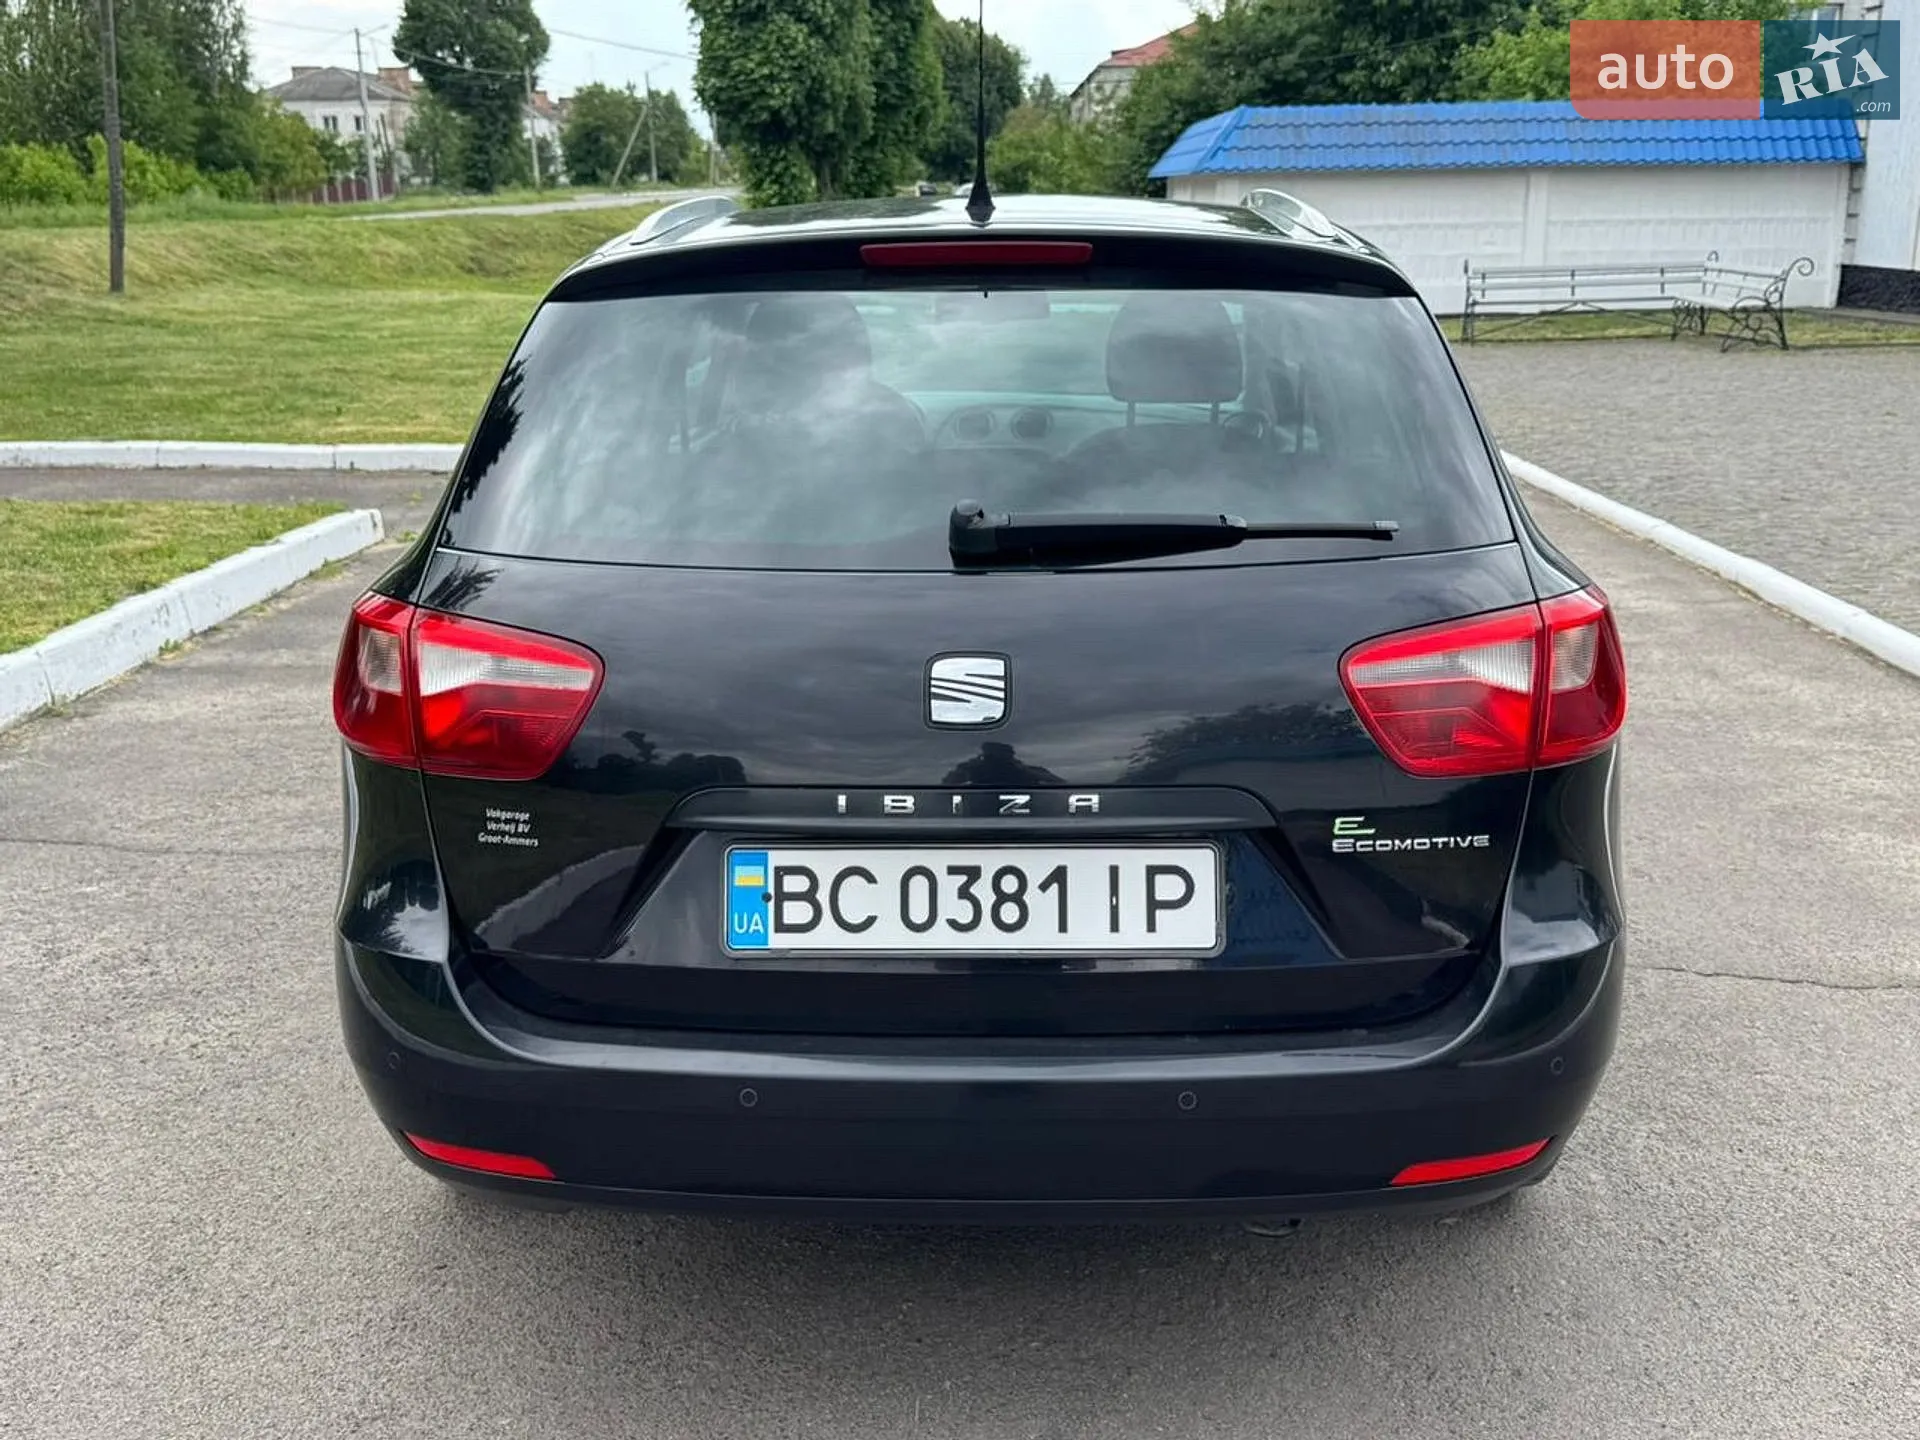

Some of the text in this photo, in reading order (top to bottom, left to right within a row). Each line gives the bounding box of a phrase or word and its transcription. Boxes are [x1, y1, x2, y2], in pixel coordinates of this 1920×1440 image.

[836, 793, 1101, 815] IBIZA
[517, 823, 531, 833] BV
[772, 864, 1196, 934] BC 0381 IP
[733, 912, 765, 935] UA
